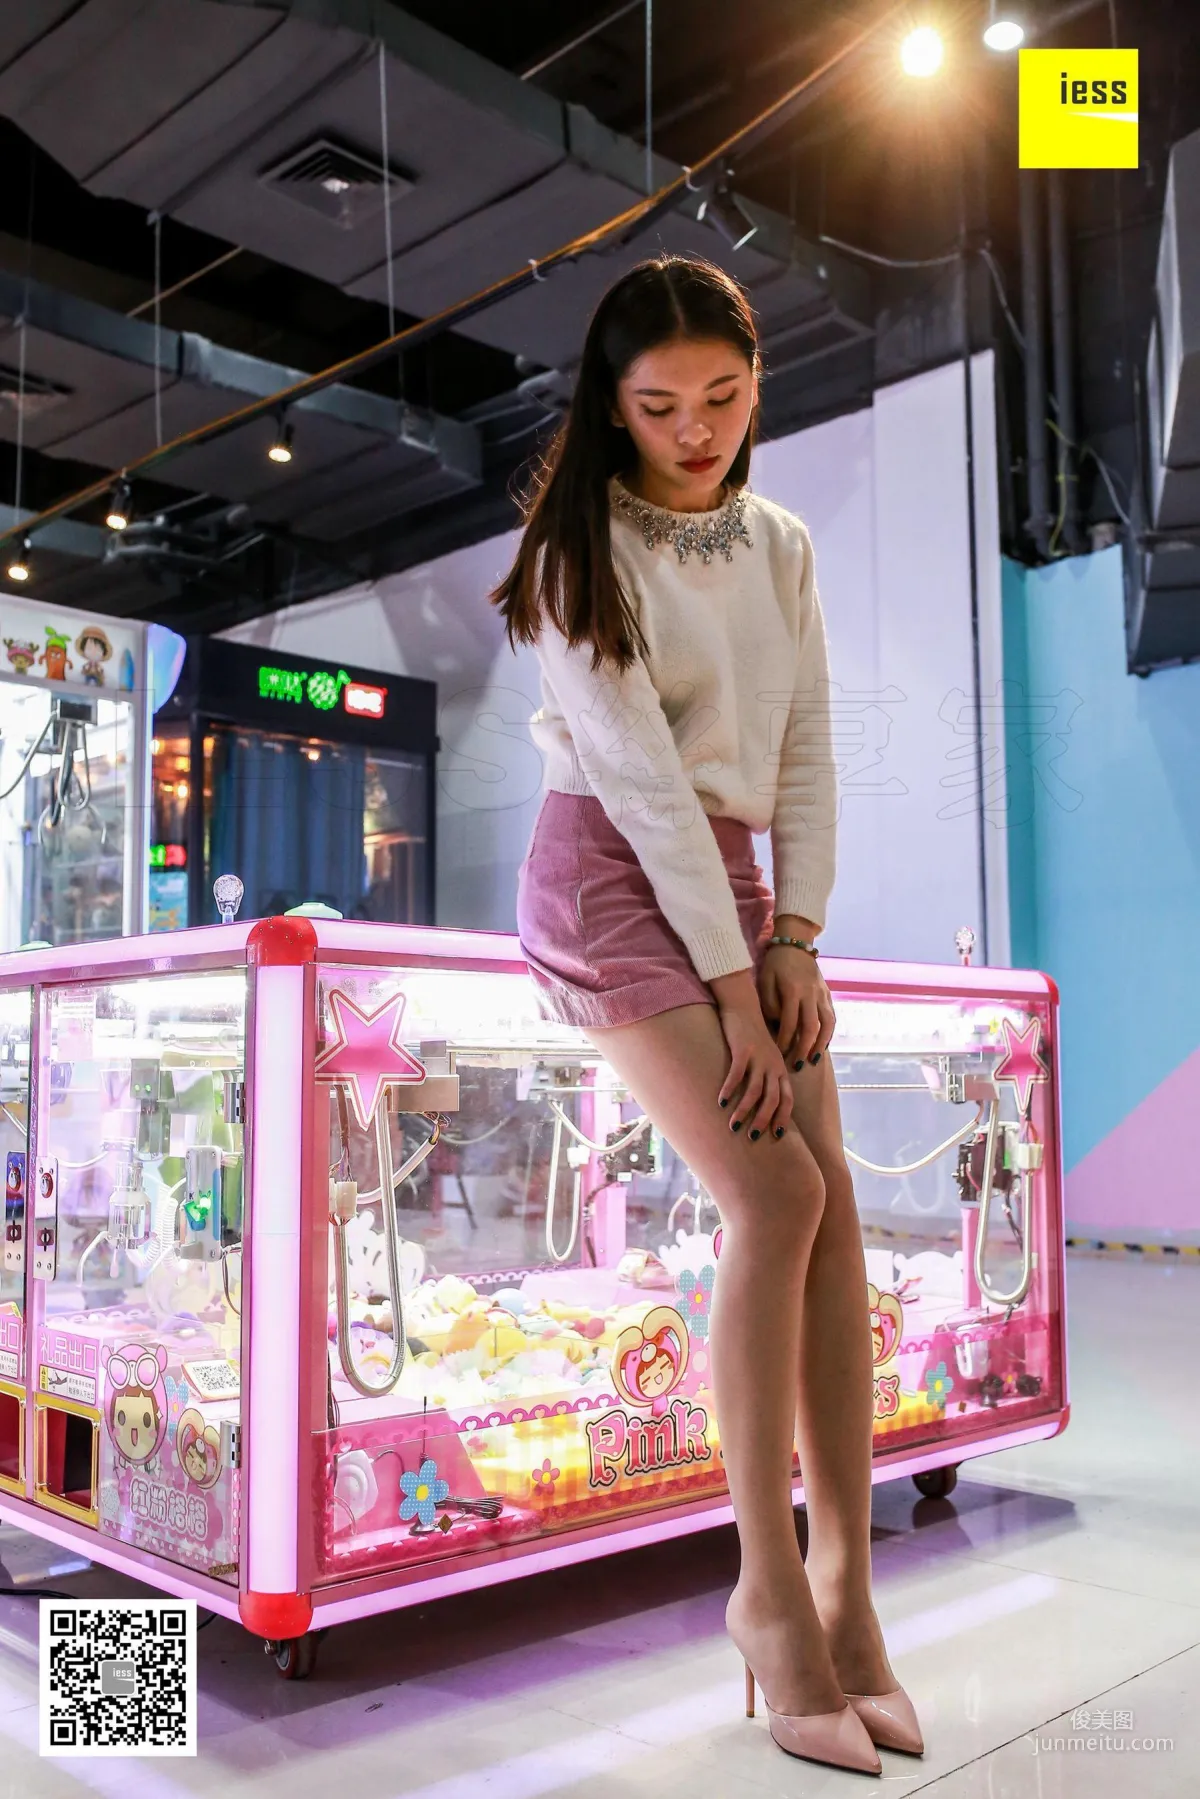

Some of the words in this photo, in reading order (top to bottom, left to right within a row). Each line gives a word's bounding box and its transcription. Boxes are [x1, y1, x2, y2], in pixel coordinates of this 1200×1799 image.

[41, 1333, 97, 1373] 礼品出口
[586, 1399, 711, 1487] Pink
[131, 1477, 207, 1539] 红粉格格
